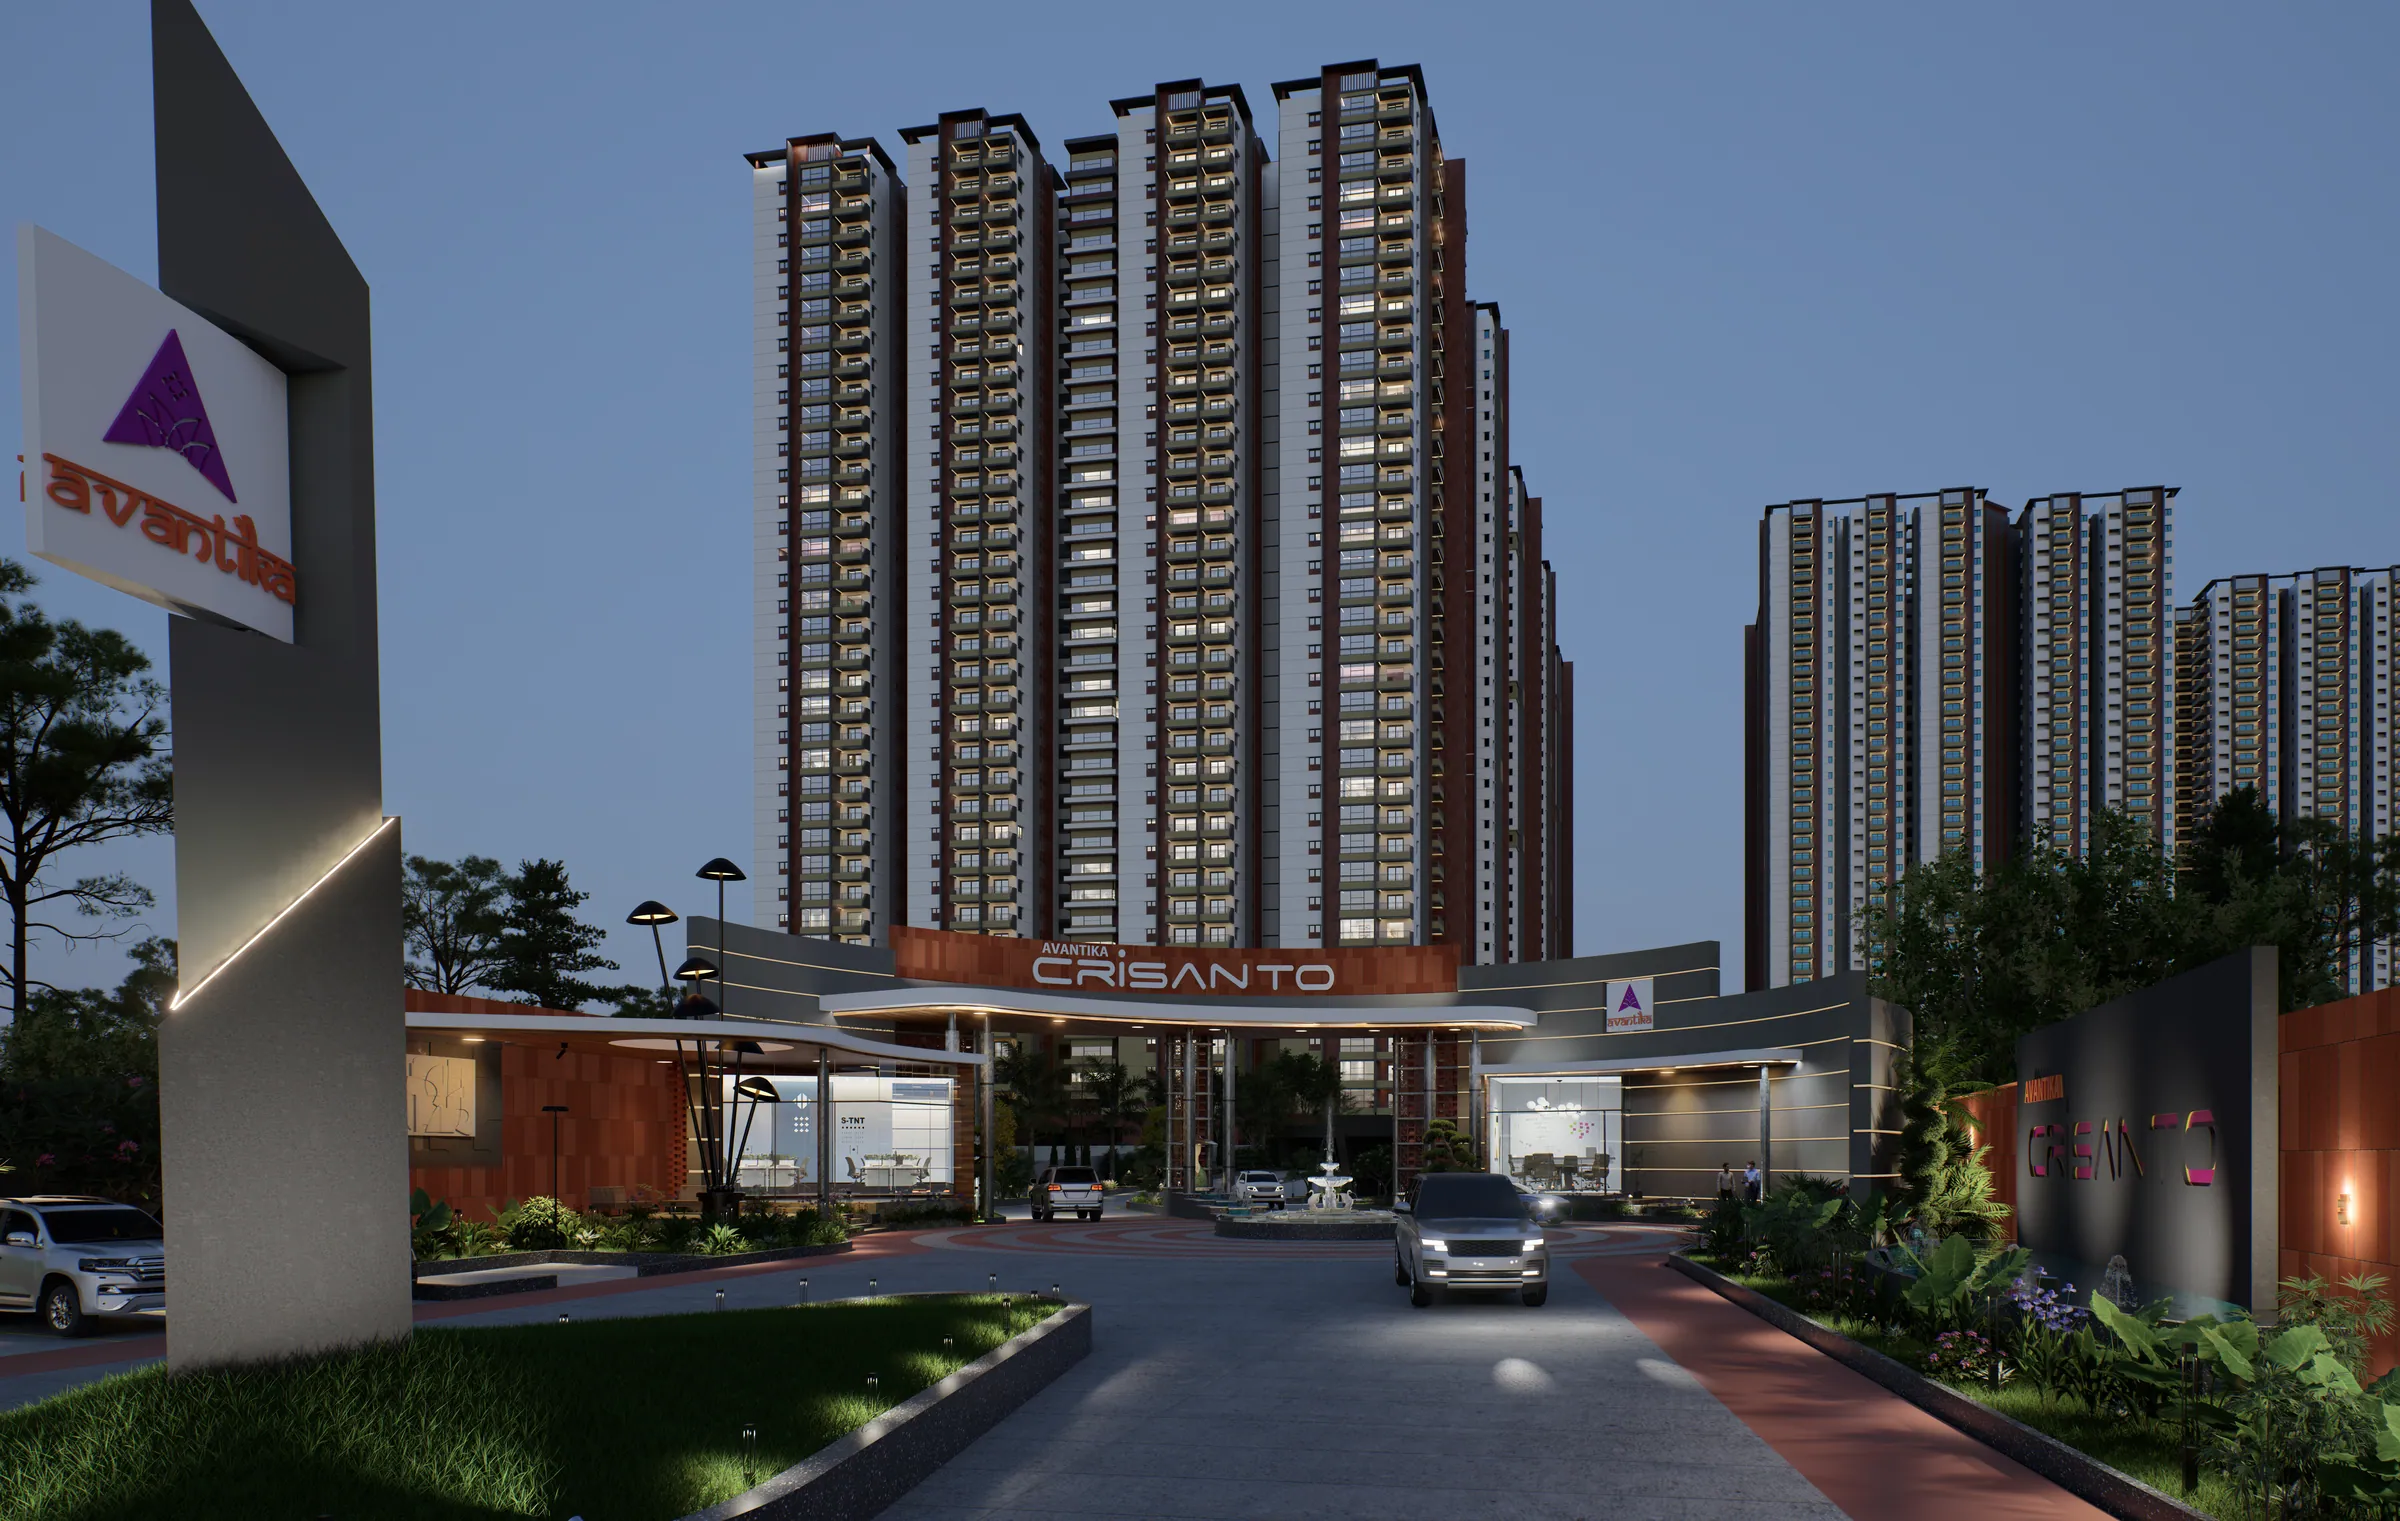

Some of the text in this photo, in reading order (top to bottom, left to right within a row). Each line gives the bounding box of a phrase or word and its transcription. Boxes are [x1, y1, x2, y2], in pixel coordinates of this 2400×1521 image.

[43, 452, 297, 605] avantika
[1041, 942, 1109, 958] AVANTIKA
[1607, 1011, 1652, 1027] avantika
